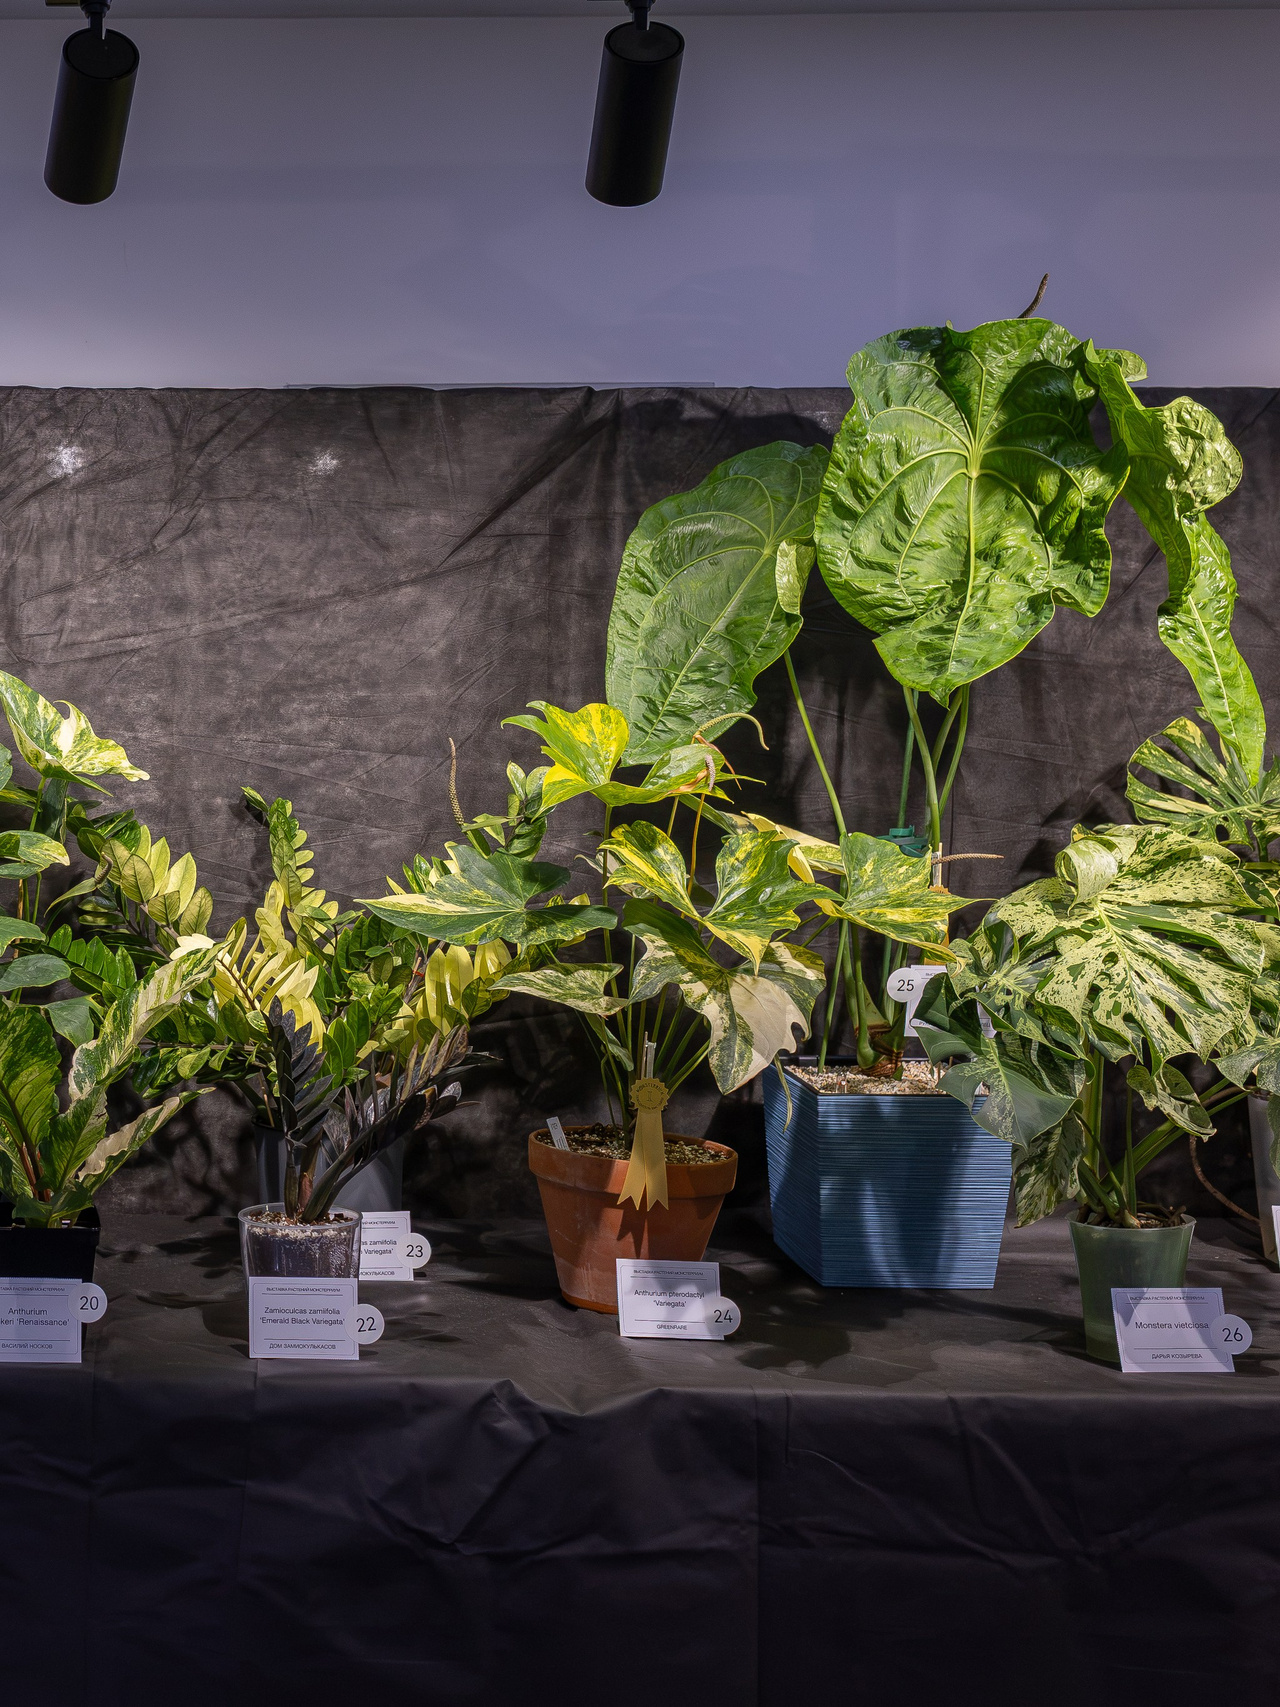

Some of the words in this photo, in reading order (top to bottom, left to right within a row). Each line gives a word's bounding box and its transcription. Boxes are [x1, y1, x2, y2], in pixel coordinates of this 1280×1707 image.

[897, 979, 914, 992] 25
[406, 1244, 423, 1257] 23
[669, 1291, 704, 1299] pterodactyl
[80, 1296, 98, 1310] 20
[714, 1309, 733, 1323] 24
[356, 1316, 376, 1332] 22
[1222, 1327, 1243, 1342] 26
